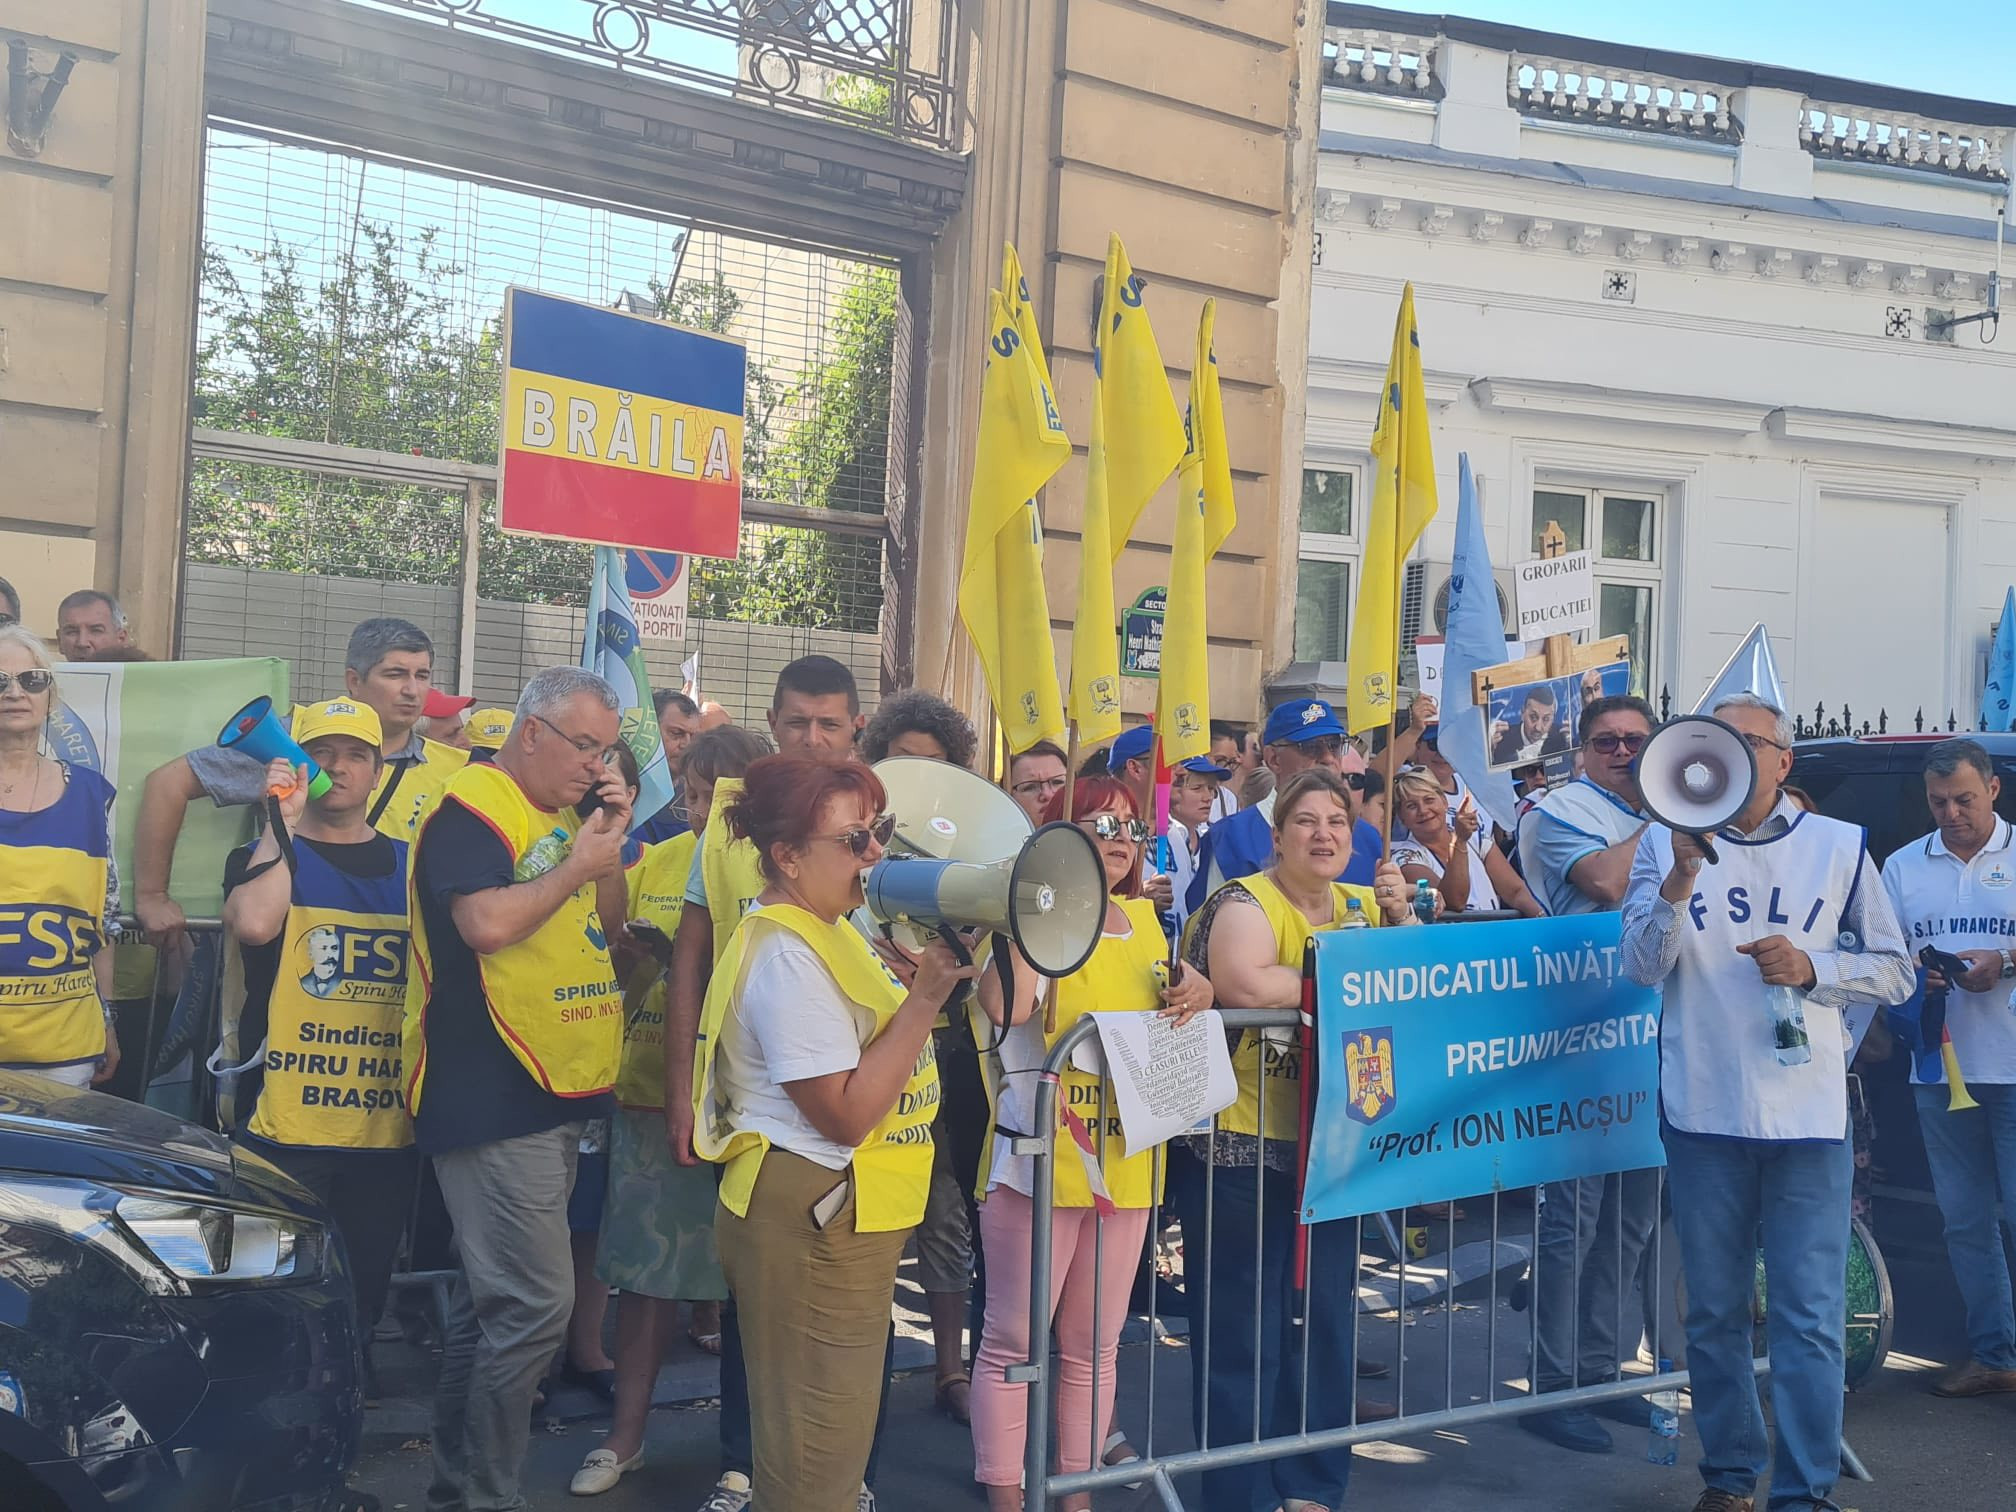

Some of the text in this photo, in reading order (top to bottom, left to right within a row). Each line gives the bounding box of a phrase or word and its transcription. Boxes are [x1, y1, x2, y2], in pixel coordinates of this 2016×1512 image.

[522, 387, 731, 481] BRĂILA
[1522, 556, 1587, 582] GROPARII
[1144, 600, 1166, 609] SECTO
[1521, 598, 1592, 626] EDUCAȚIEI
[1151, 619, 1163, 635] Stra
[641, 894, 683, 903] FEDERAT
[1950, 917, 2016, 937] VRANCEA
[344, 932, 408, 979] FS
[1341, 940, 1624, 1007] SINDICATUL ÎNVĂȚ
[340, 981, 387, 999] Spiru
[554, 981, 607, 1002] SPIRU
[561, 1005, 596, 1023] SIND.
[267, 1050, 348, 1076] SPIRU
[1145, 1056, 1179, 1077] CEASURI
[1453, 1110, 1505, 1149] ION
